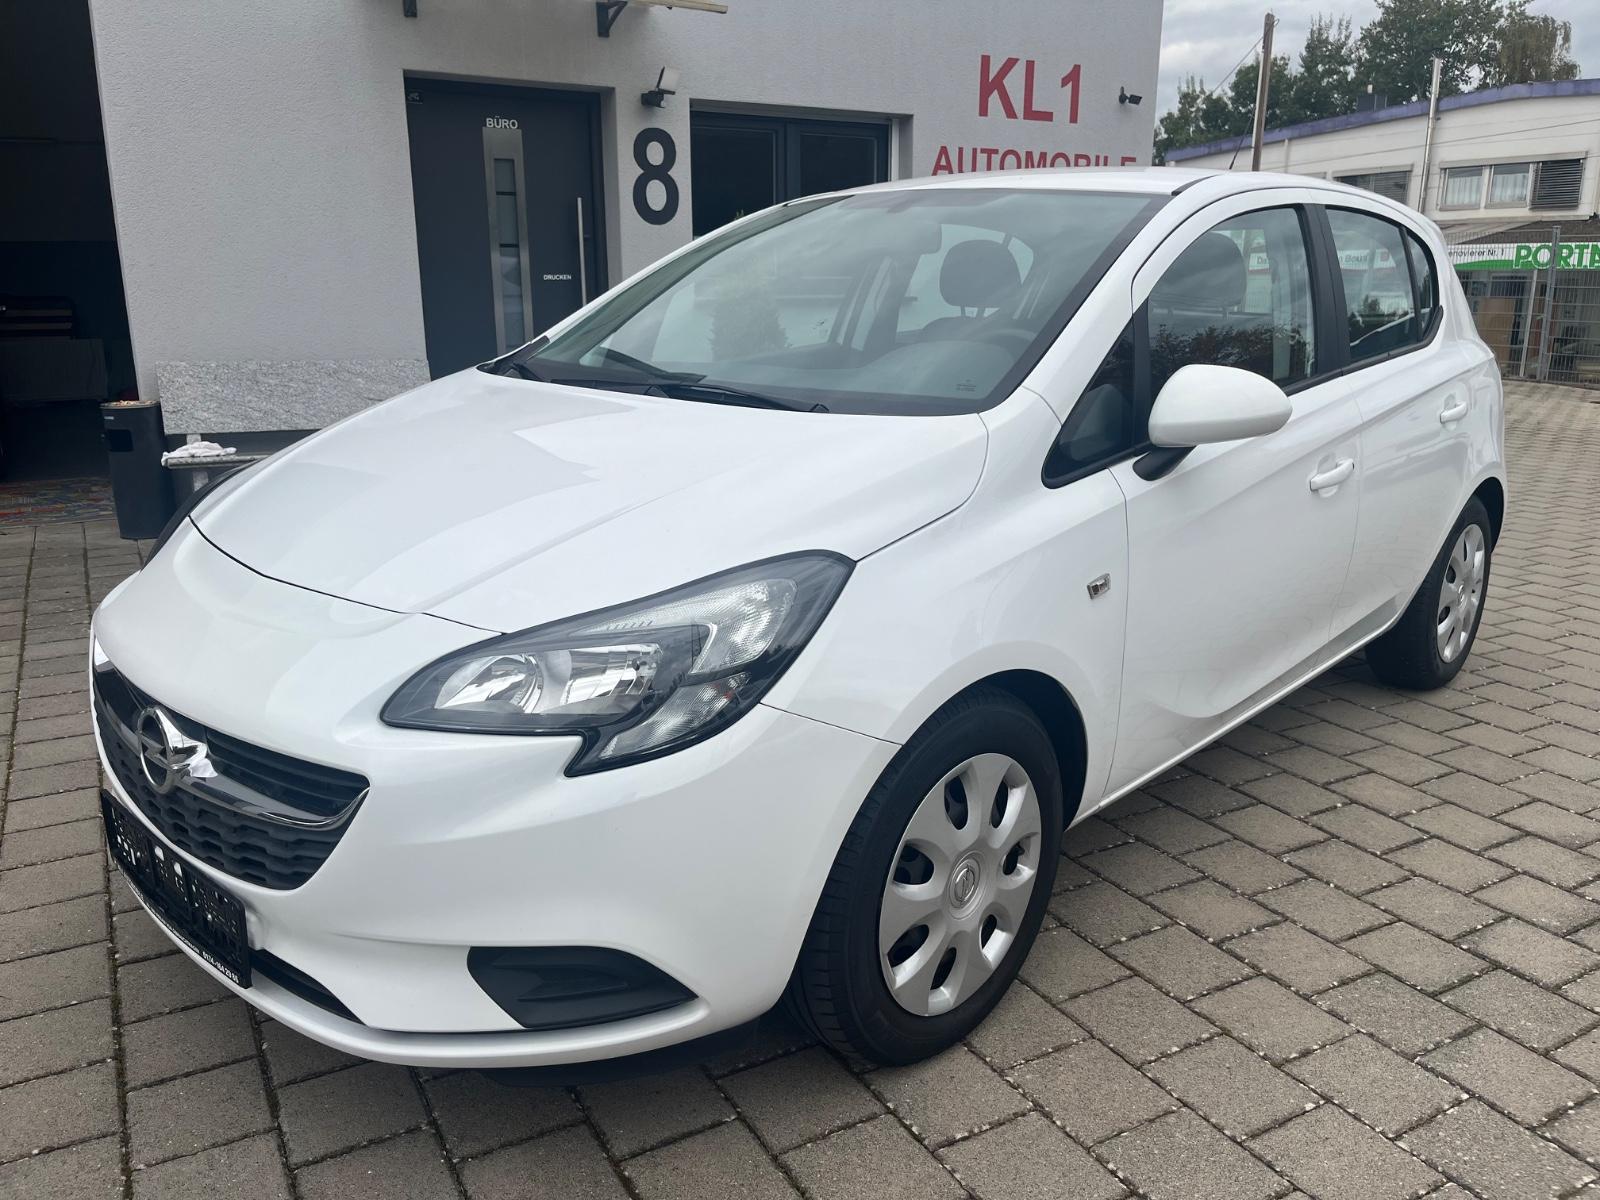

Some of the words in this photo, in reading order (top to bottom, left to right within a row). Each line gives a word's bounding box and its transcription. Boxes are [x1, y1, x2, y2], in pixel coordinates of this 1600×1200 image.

[979, 54, 1081, 124] KL1
[486, 116, 519, 129] BÜRO
[633, 127, 680, 225] 8
[543, 273, 572, 281] DRUCKEN
